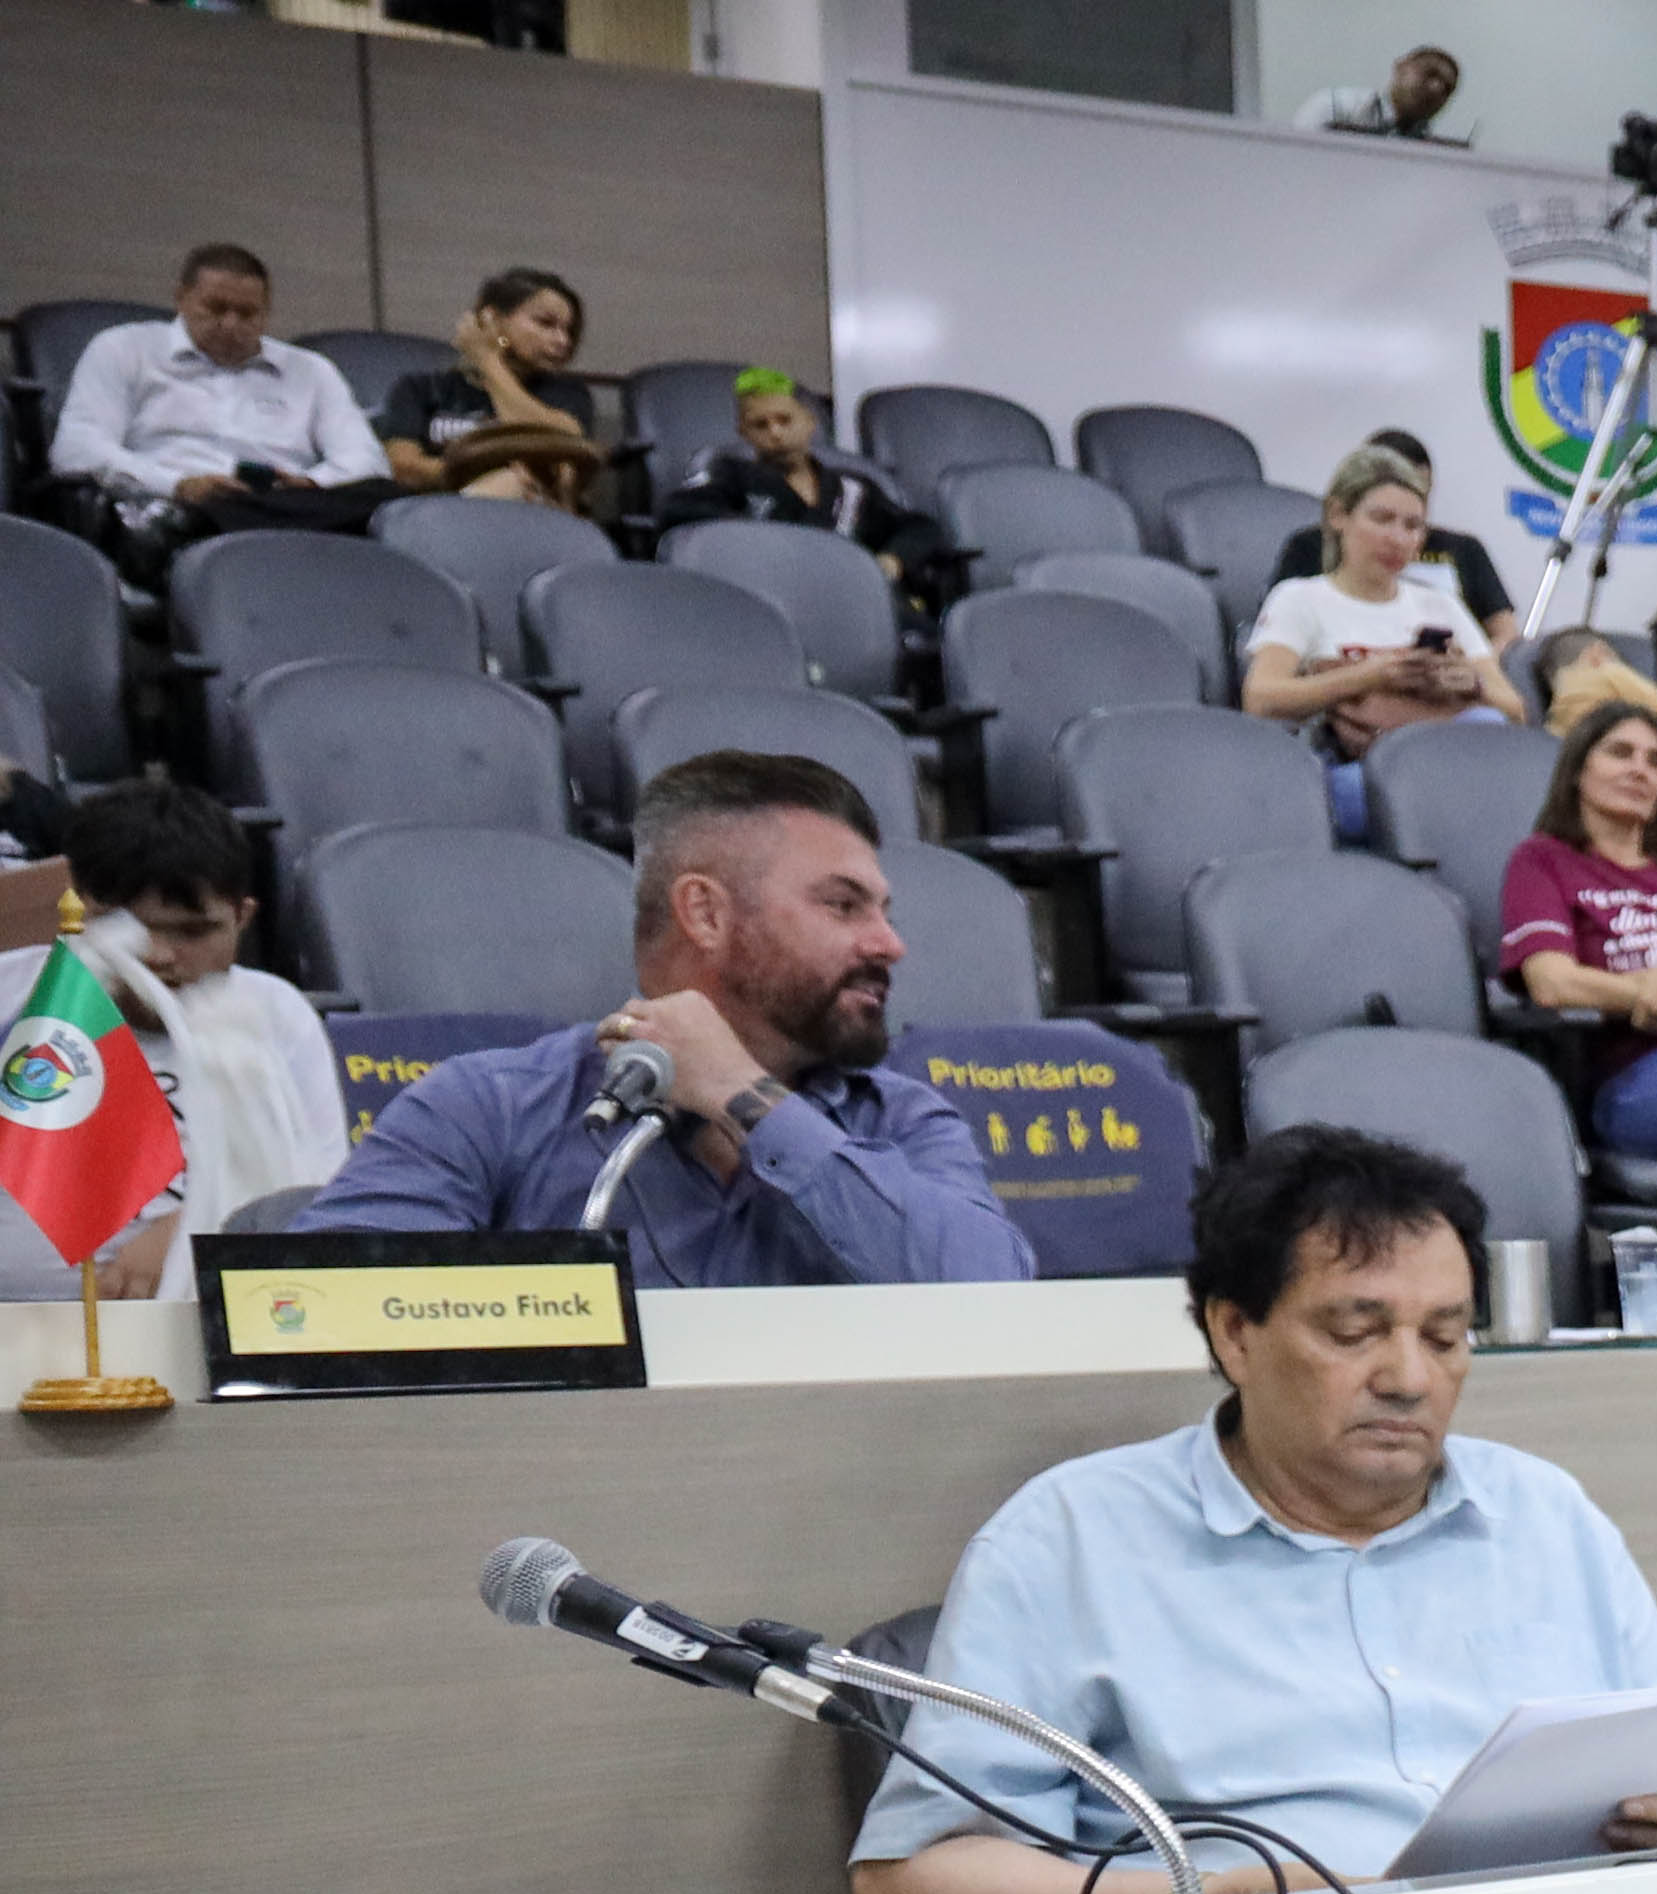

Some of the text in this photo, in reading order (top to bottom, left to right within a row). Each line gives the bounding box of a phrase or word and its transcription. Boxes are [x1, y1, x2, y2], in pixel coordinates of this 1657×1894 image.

[928, 1057, 1116, 1091] Prioritário
[382, 1293, 592, 1320] Gustavo Finck
